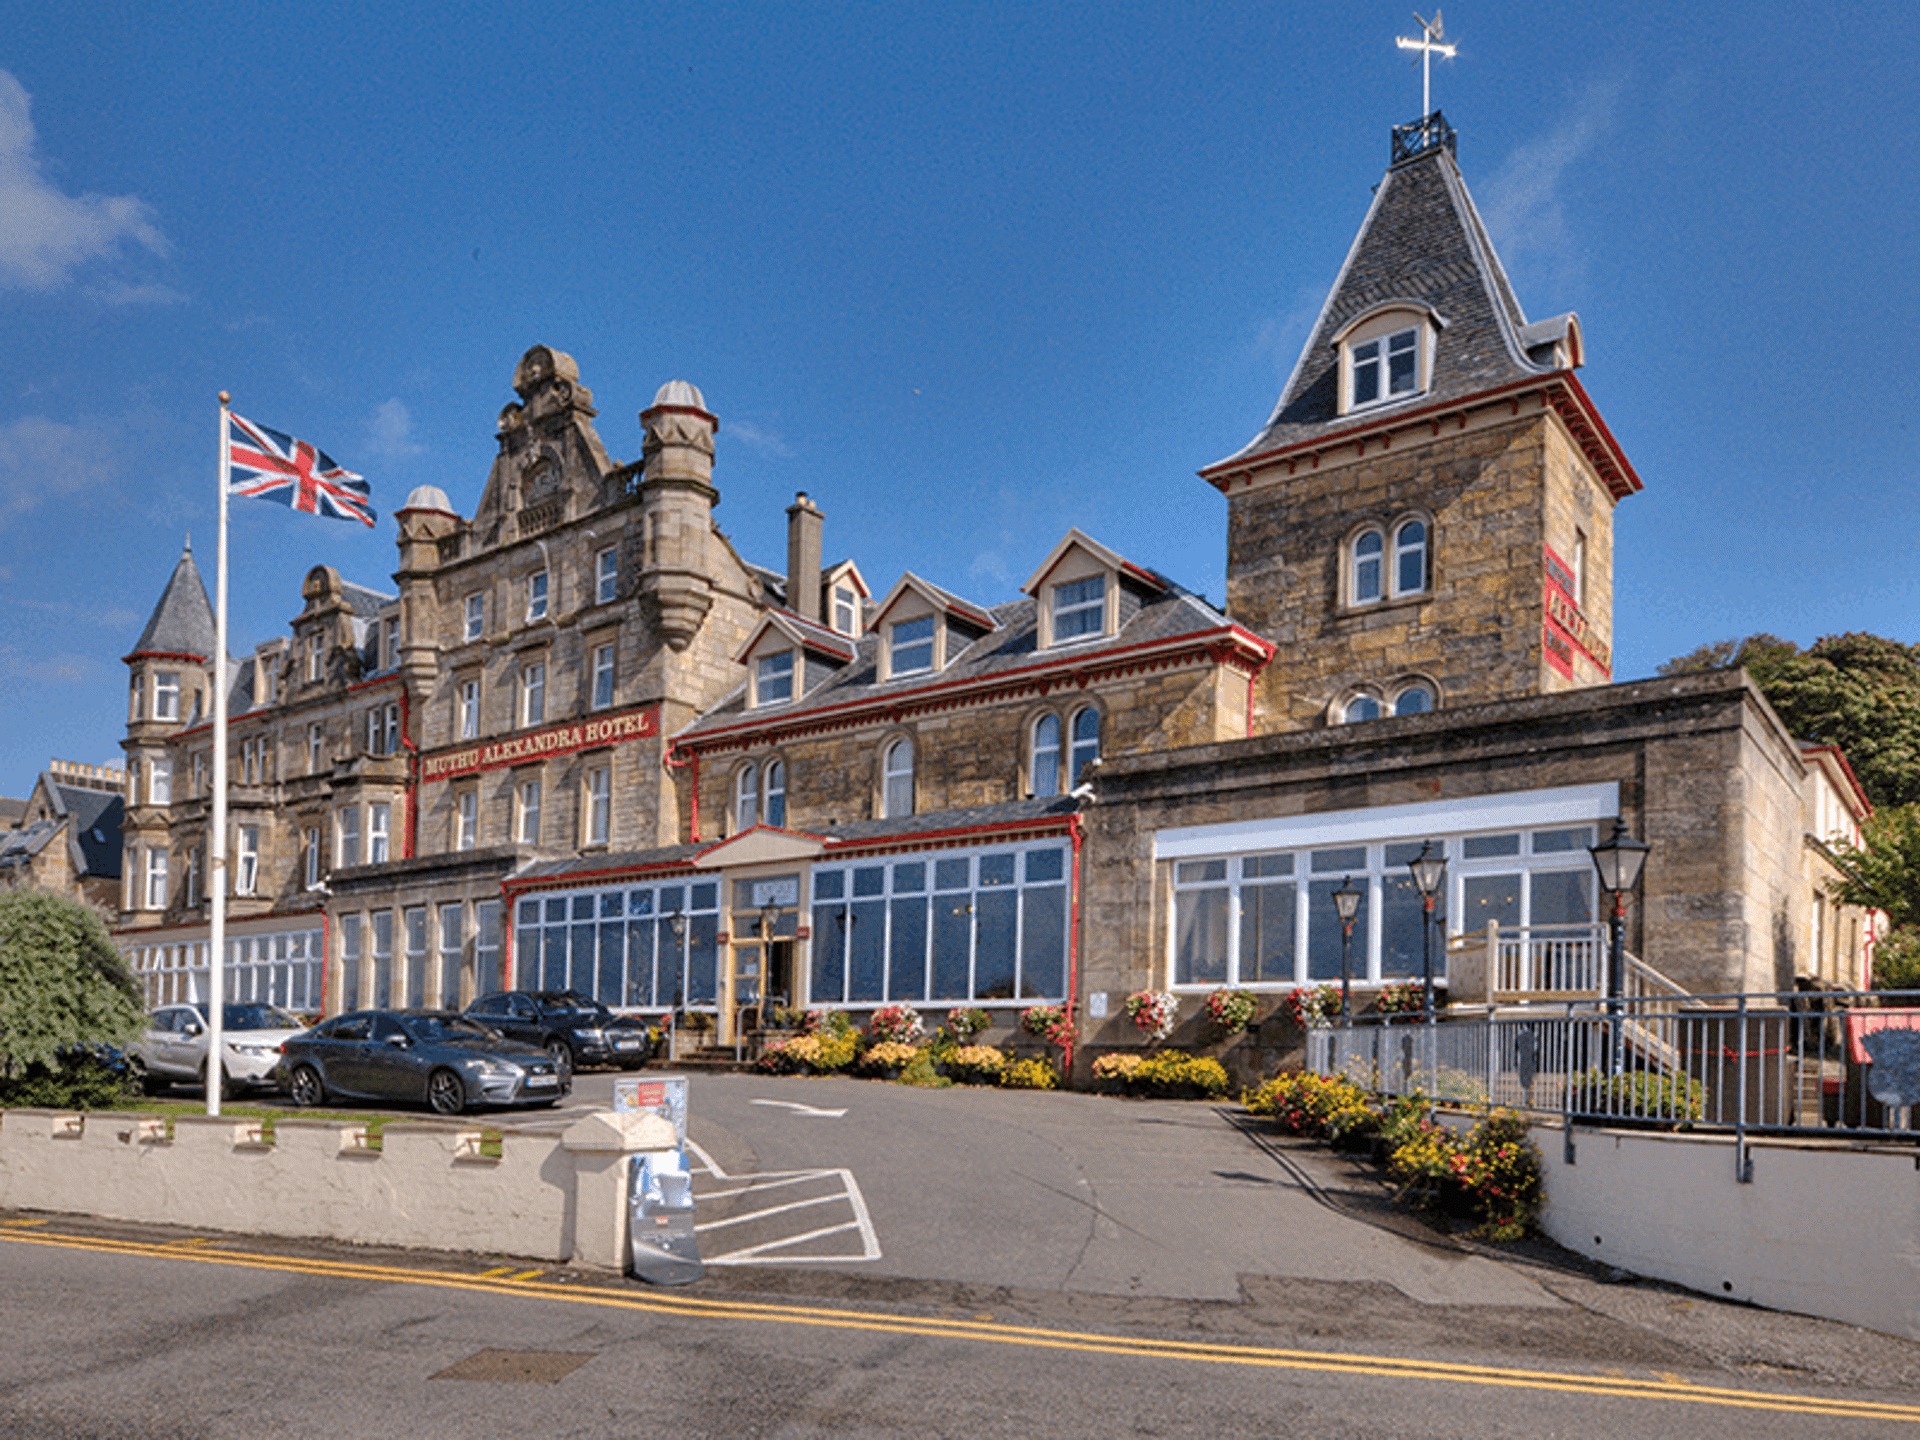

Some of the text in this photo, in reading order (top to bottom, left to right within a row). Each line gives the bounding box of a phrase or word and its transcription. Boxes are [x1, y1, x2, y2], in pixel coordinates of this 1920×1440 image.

[425, 713, 649, 776] MUTHU ALEXANDRA HOTEL
